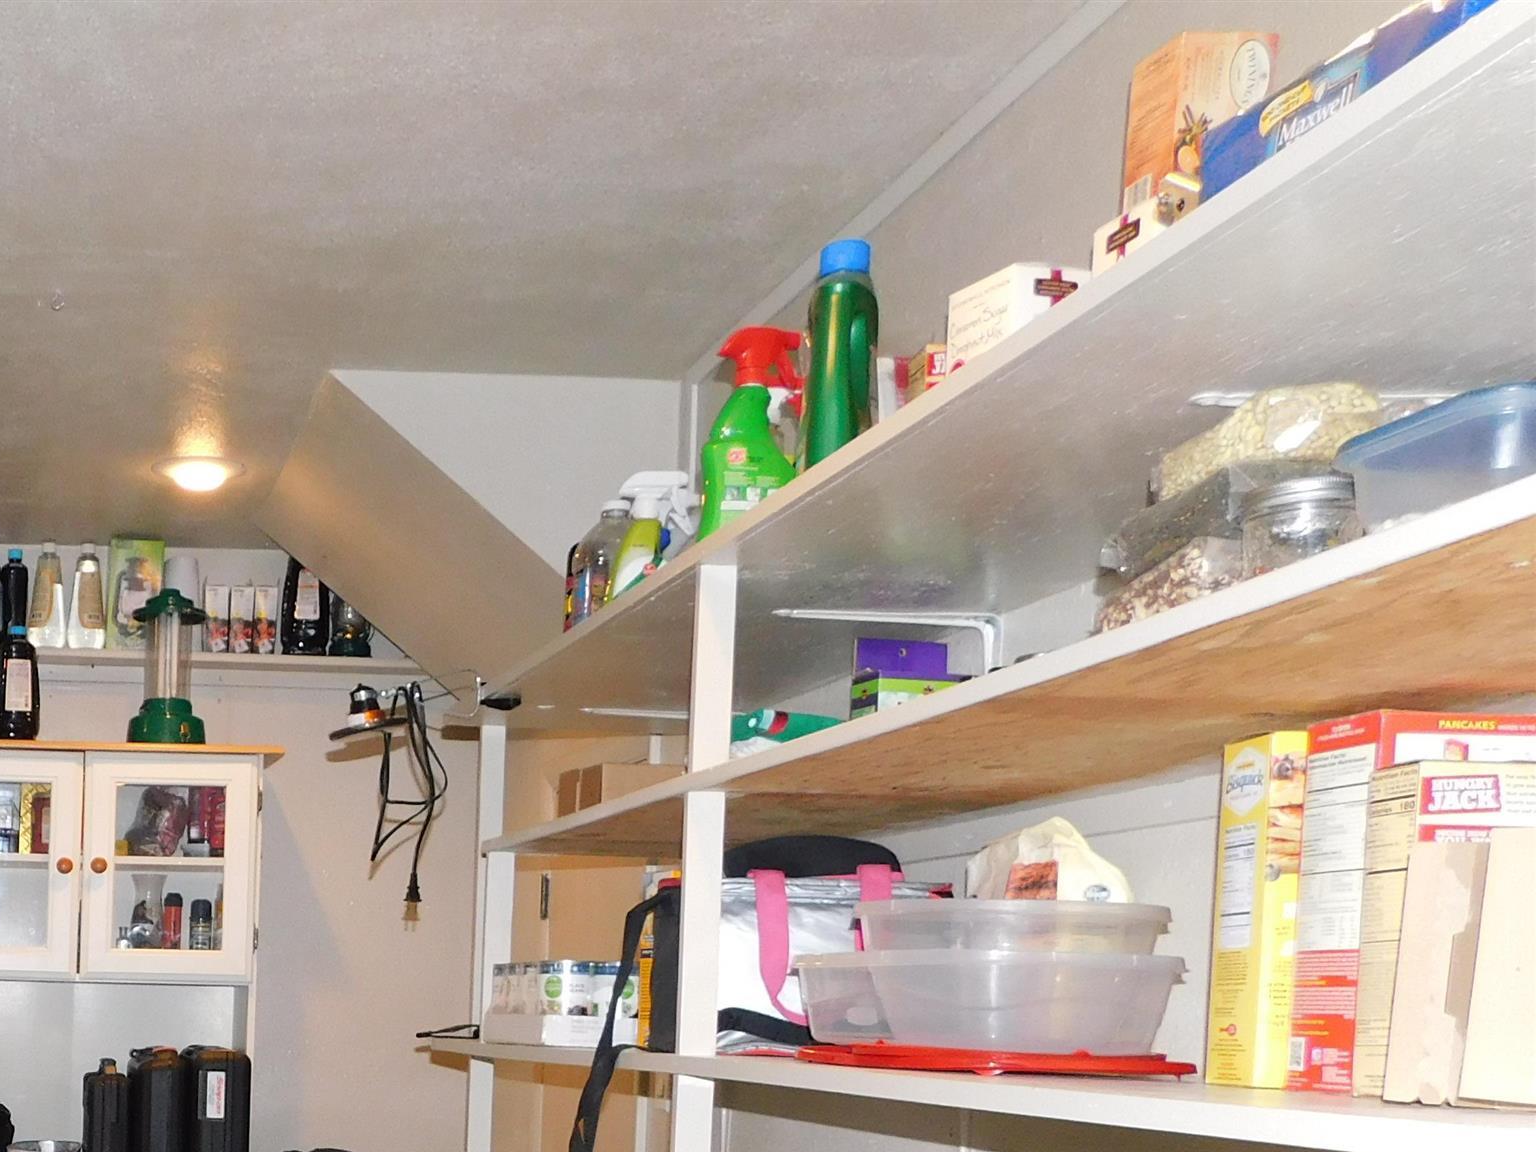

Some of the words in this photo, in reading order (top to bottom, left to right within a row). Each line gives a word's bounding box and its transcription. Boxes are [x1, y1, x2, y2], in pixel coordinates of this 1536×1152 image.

[1278, 83, 1355, 146] Maxwell
[1438, 719, 1497, 731] PANCAKES
[1428, 790, 1502, 811] JACK
